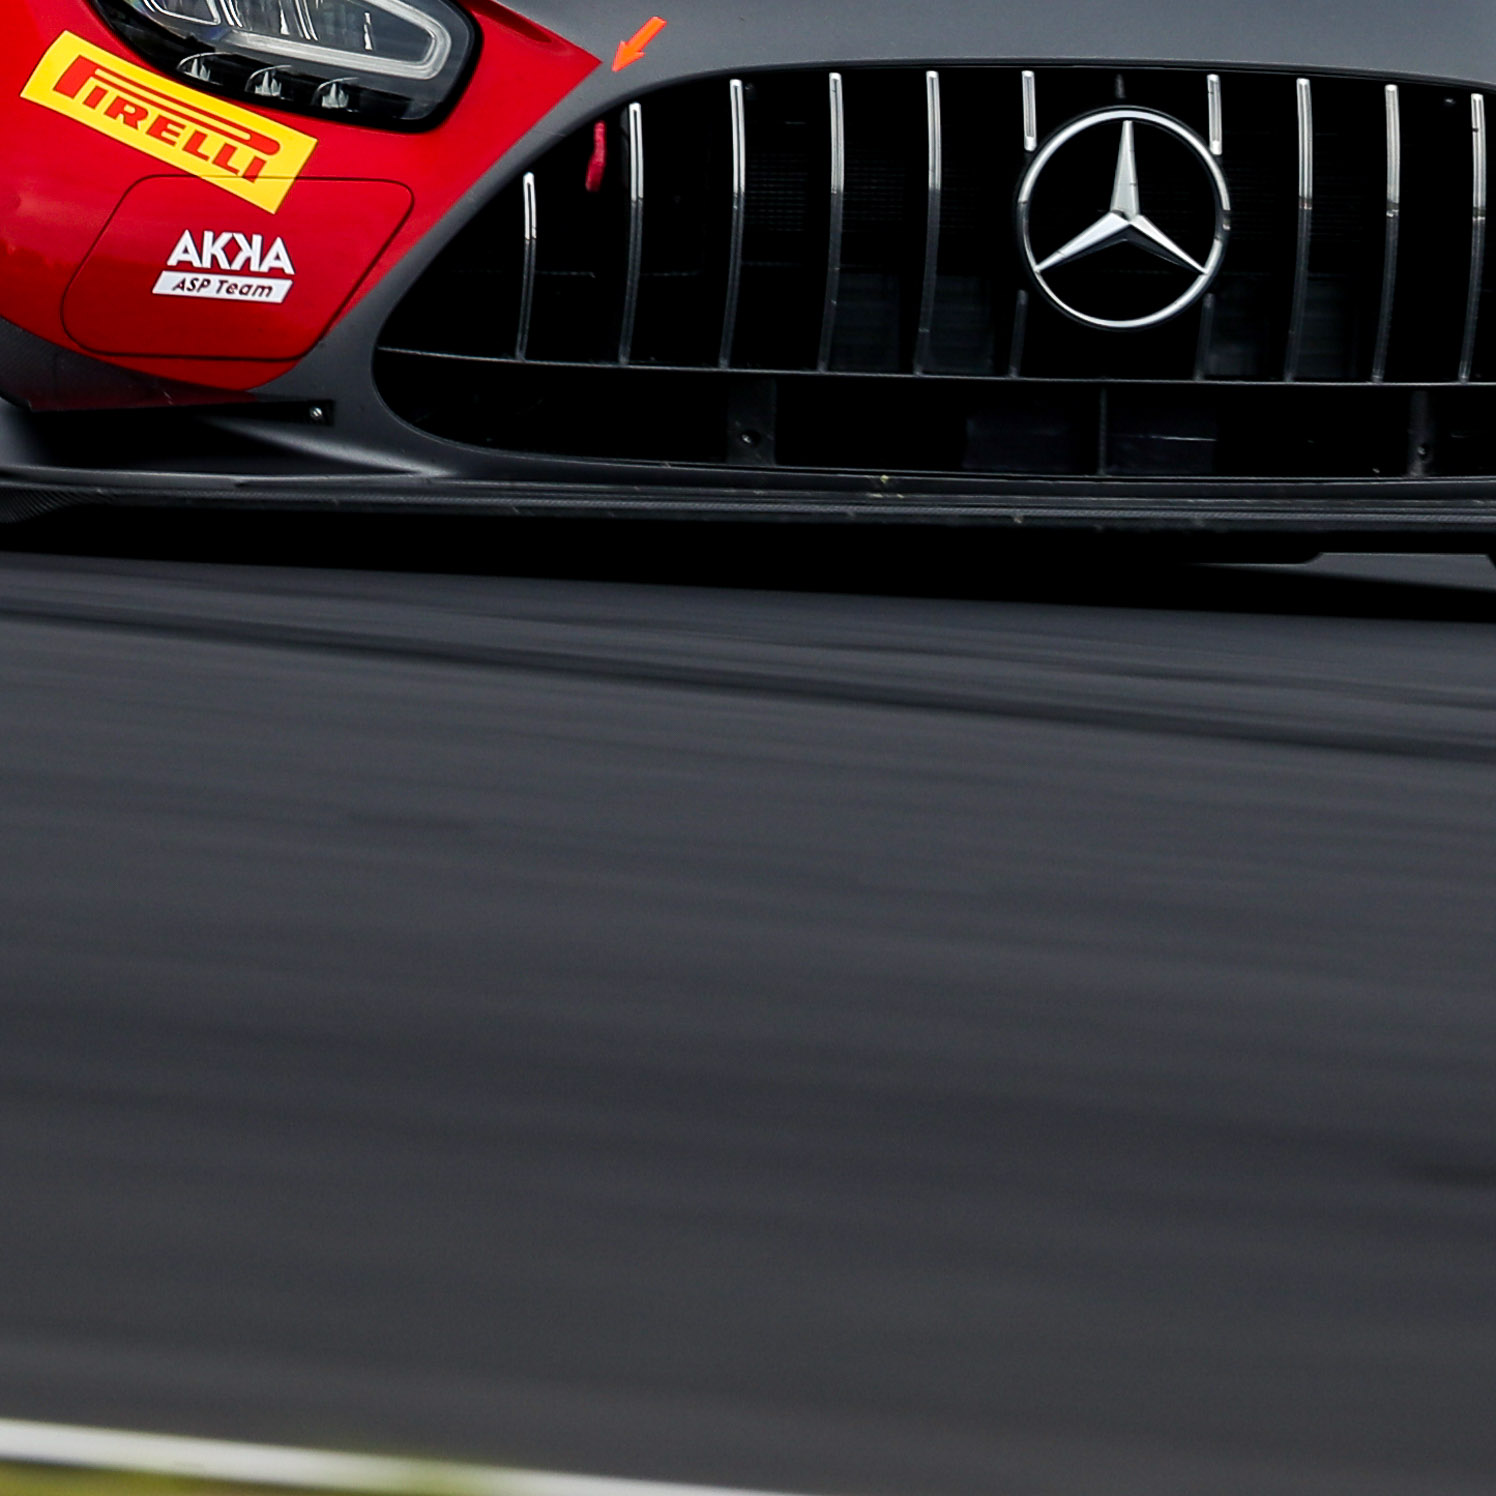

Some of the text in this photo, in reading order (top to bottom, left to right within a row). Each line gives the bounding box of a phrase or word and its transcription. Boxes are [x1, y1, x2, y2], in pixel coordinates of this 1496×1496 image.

[52, 54, 280, 183] PIRELLI
[166, 229, 295, 275] AKKA
[172, 277, 274, 298] ASP Team
